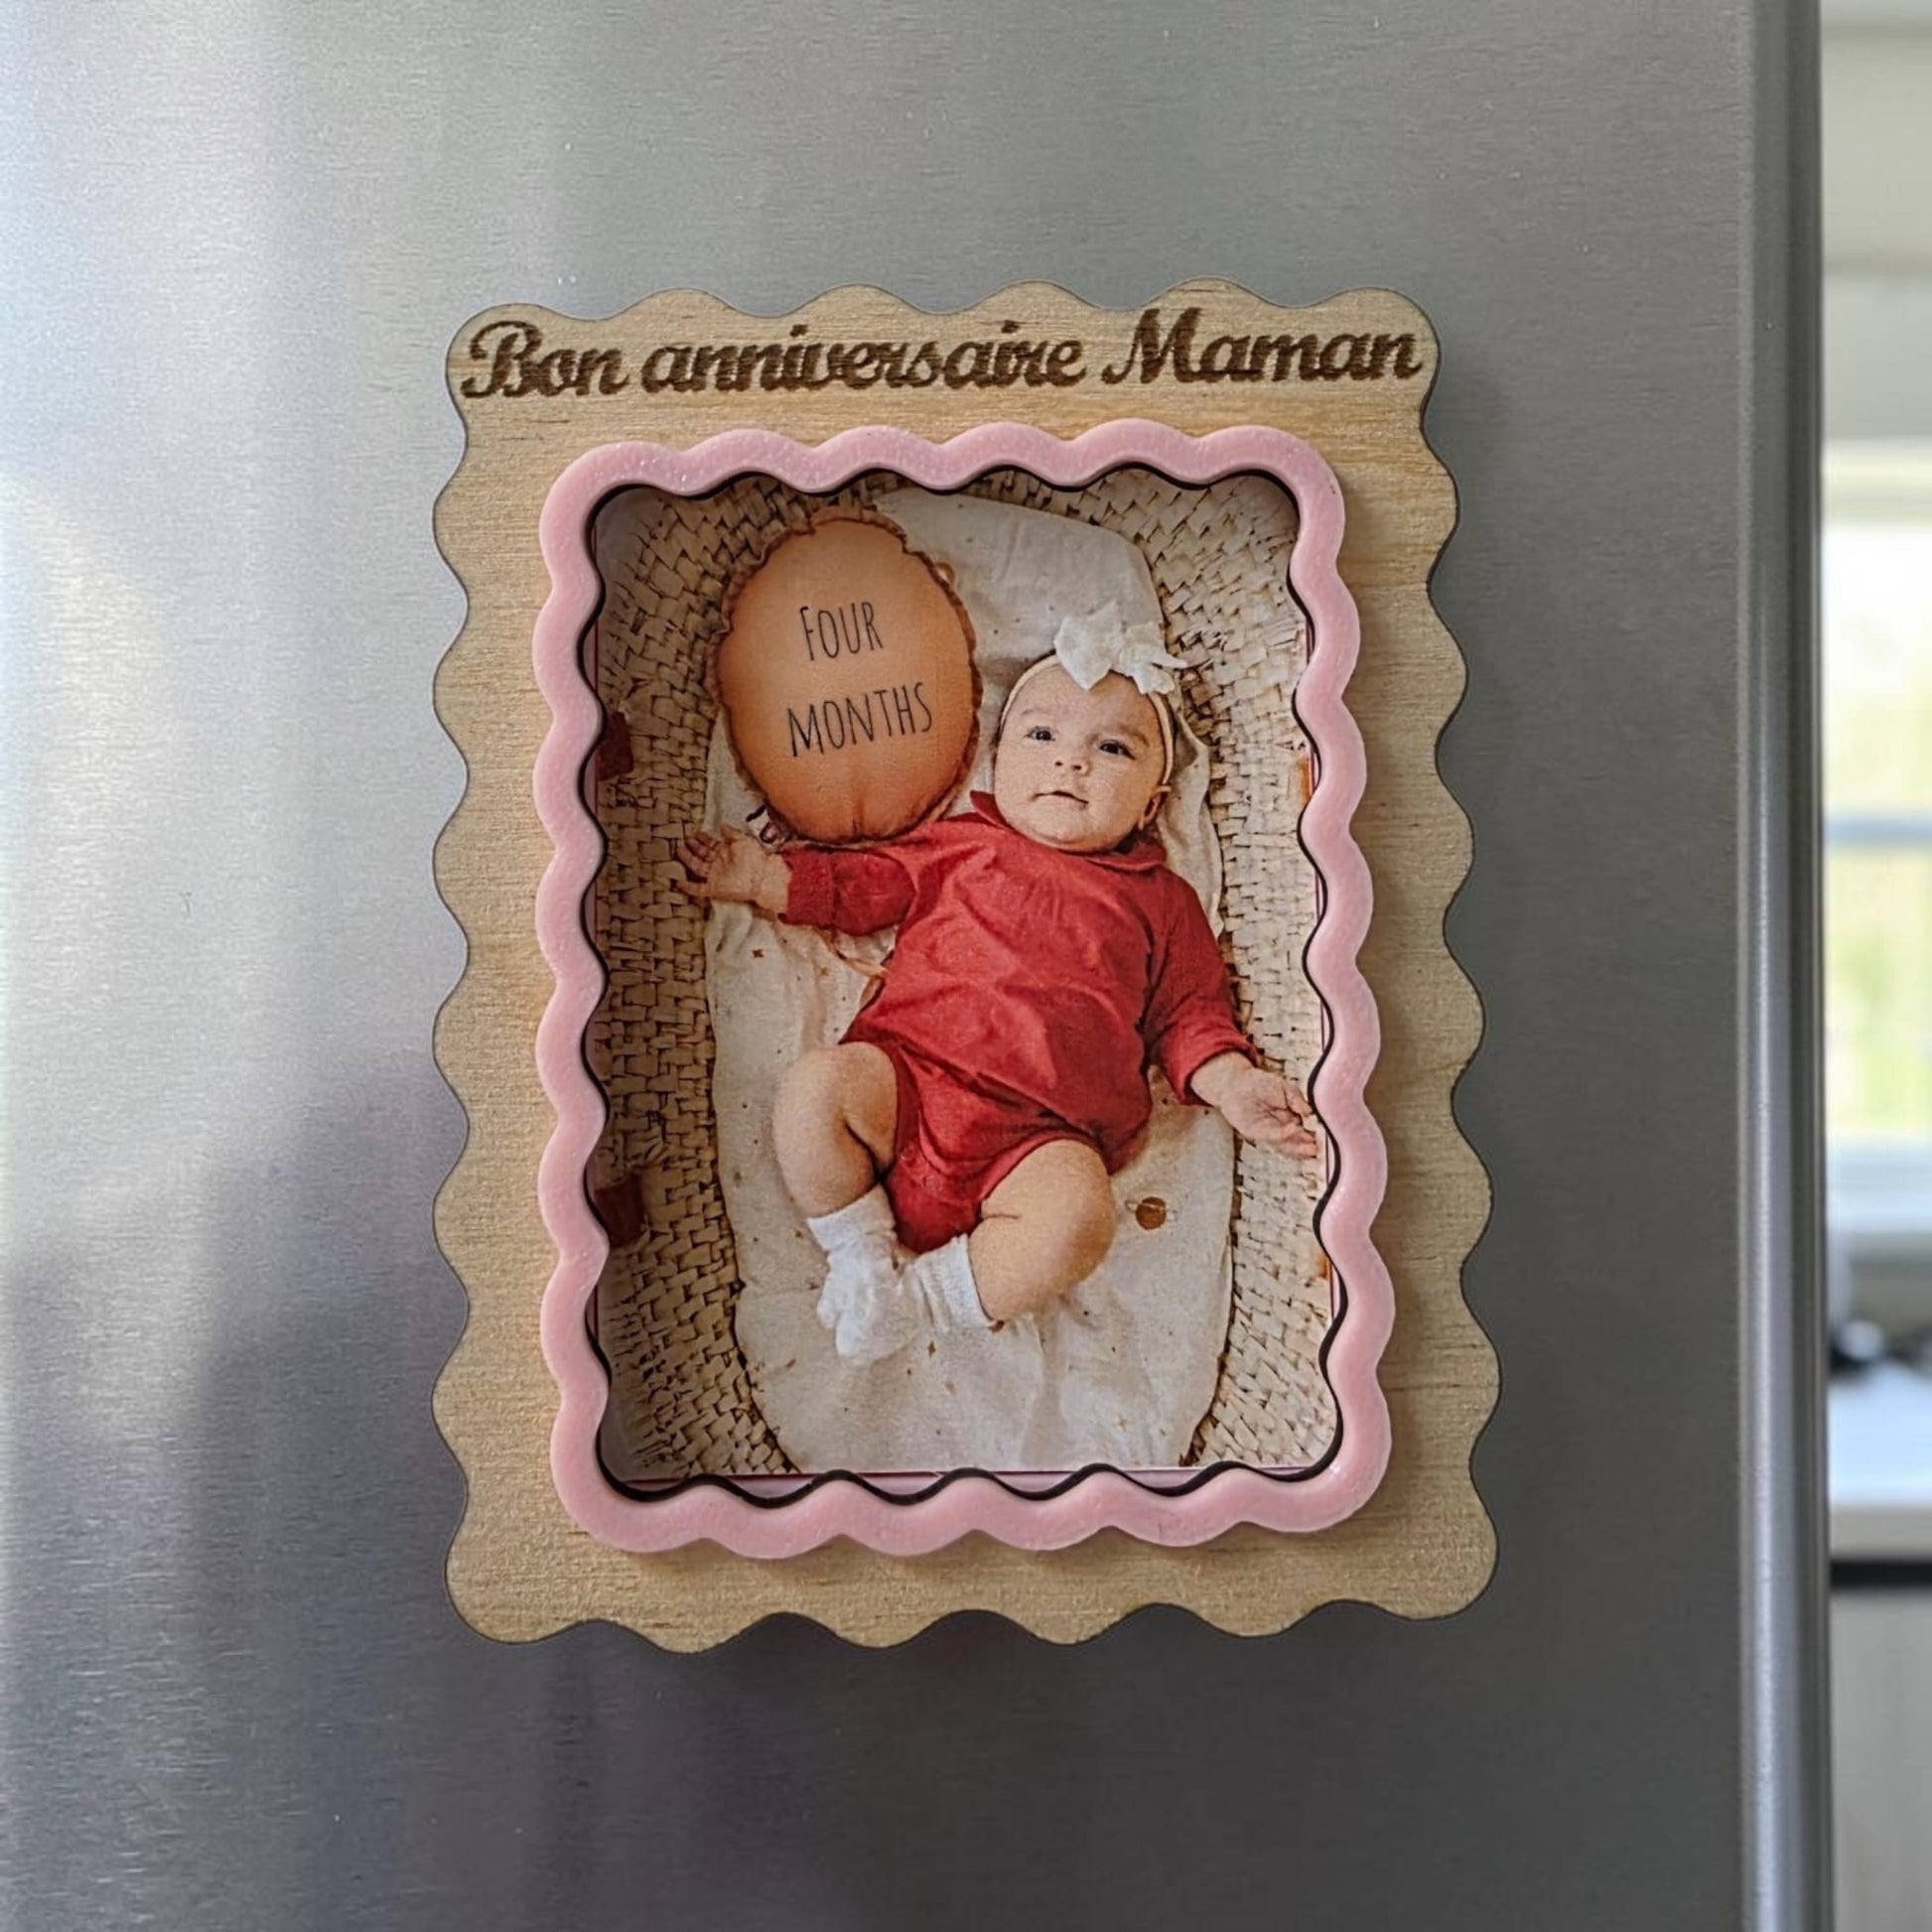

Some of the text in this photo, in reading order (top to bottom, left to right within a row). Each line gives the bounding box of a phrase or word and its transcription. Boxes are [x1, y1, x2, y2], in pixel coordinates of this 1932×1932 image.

[461, 307, 1424, 397] Bon anniversaire Maman
[799, 601, 884, 661] FOUR
[786, 681, 933, 758] MONTHS
